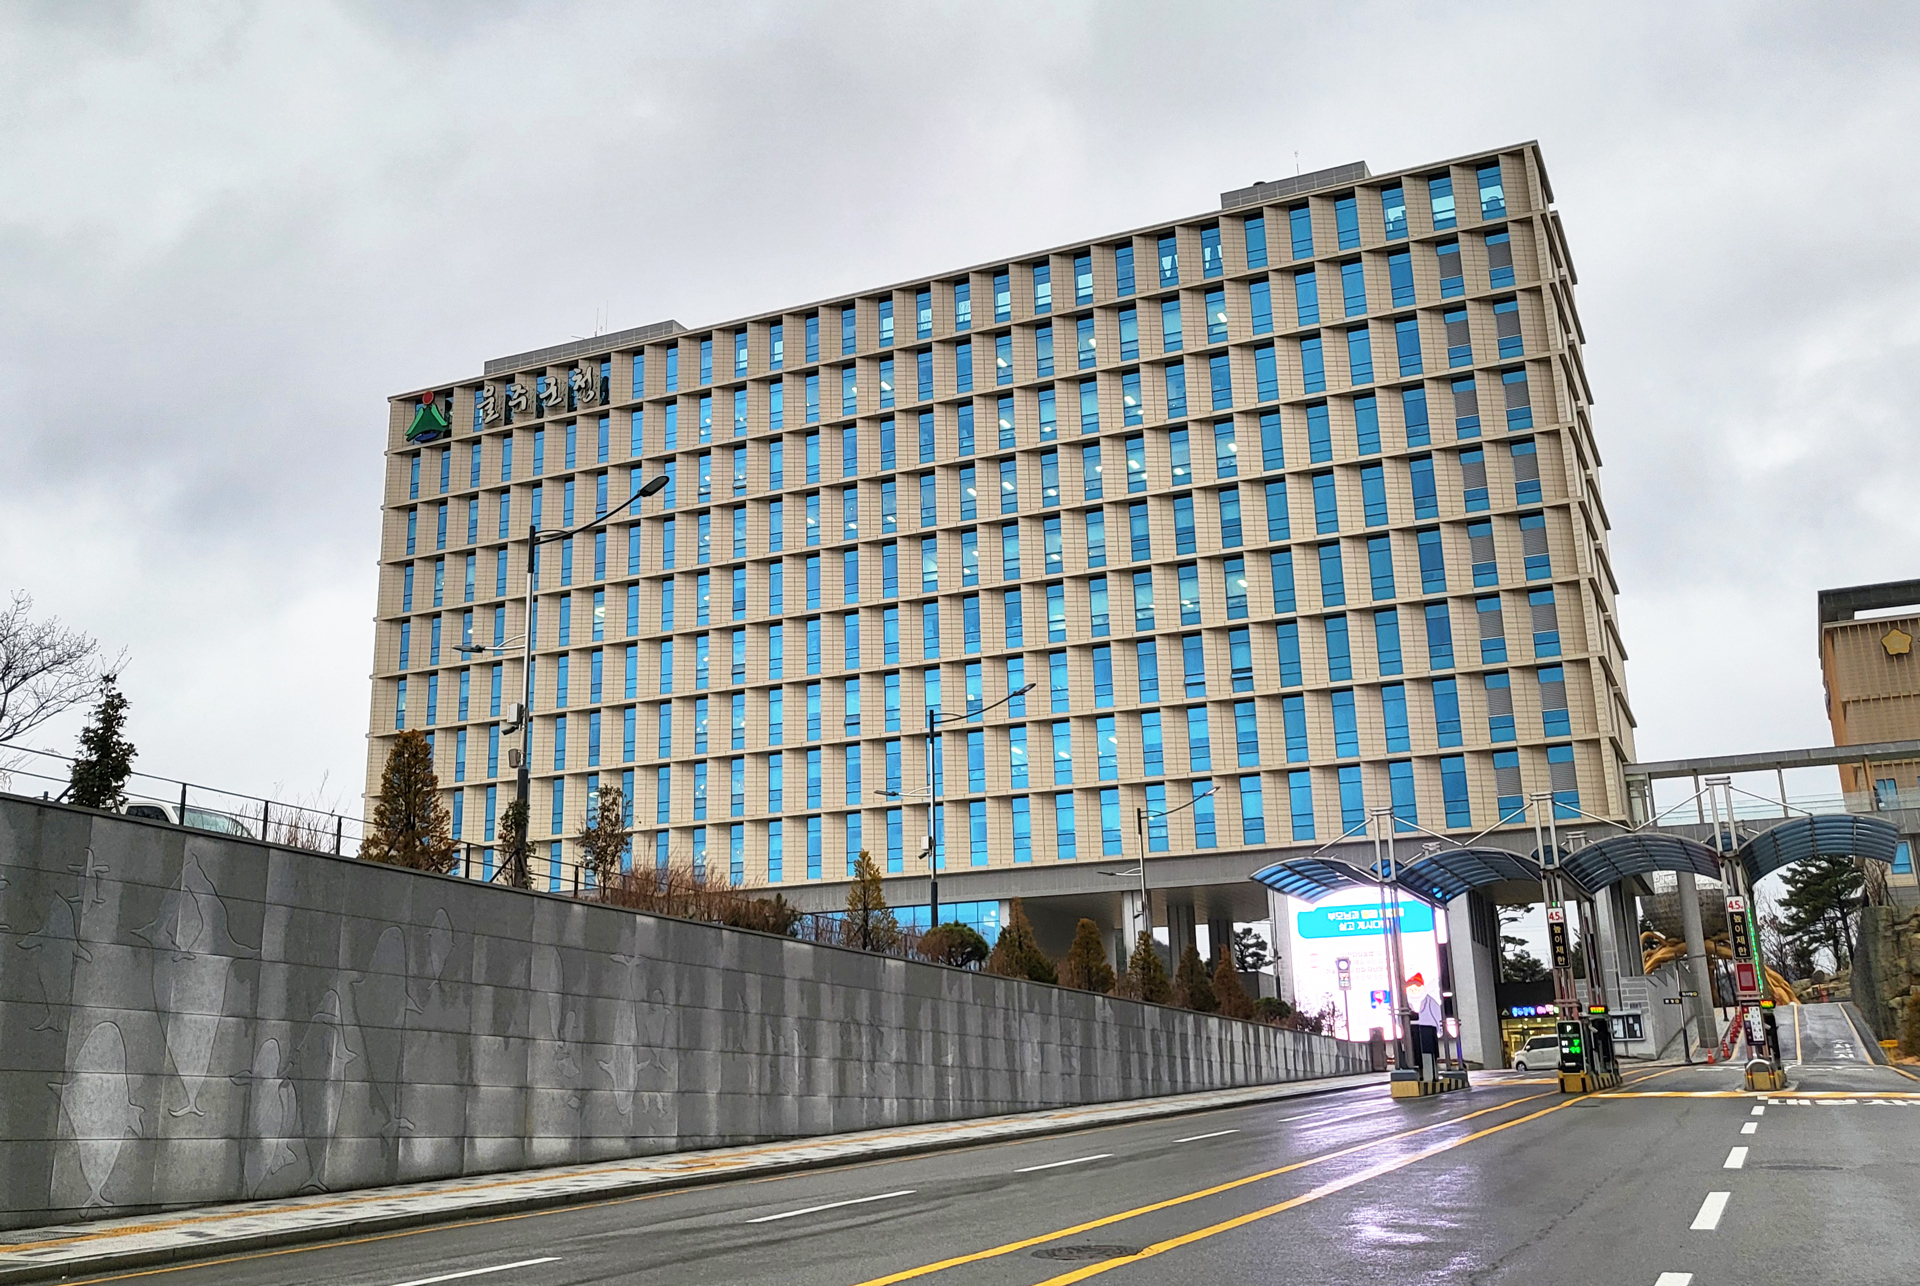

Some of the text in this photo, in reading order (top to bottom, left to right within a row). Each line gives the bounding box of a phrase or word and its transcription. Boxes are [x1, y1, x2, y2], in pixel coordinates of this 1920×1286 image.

[476, 365, 597, 424] 울주군청
[1553, 924, 1566, 966] 높이제한
[1733, 914, 1748, 956] 높이제한
[1566, 1025, 1572, 1033] P
